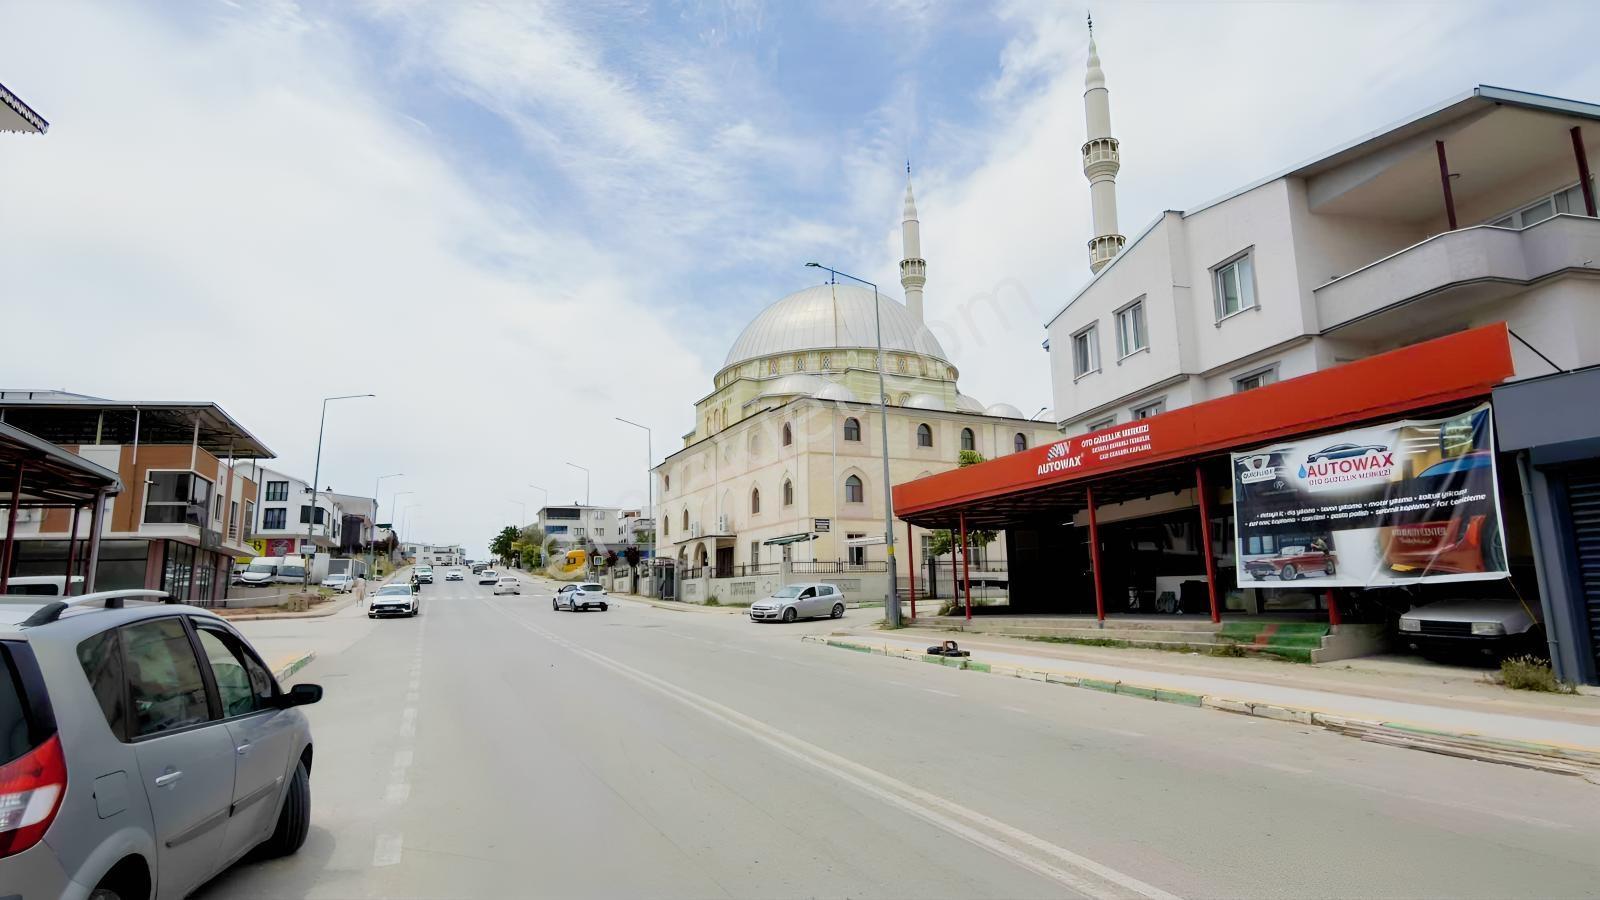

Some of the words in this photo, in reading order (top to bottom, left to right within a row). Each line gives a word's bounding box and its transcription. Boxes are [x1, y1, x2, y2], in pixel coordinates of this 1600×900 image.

[1081, 438, 1093, 448] OTO
[1038, 455, 1082, 476] AUTOWAX
[1307, 453, 1394, 478] AUTOWAX
